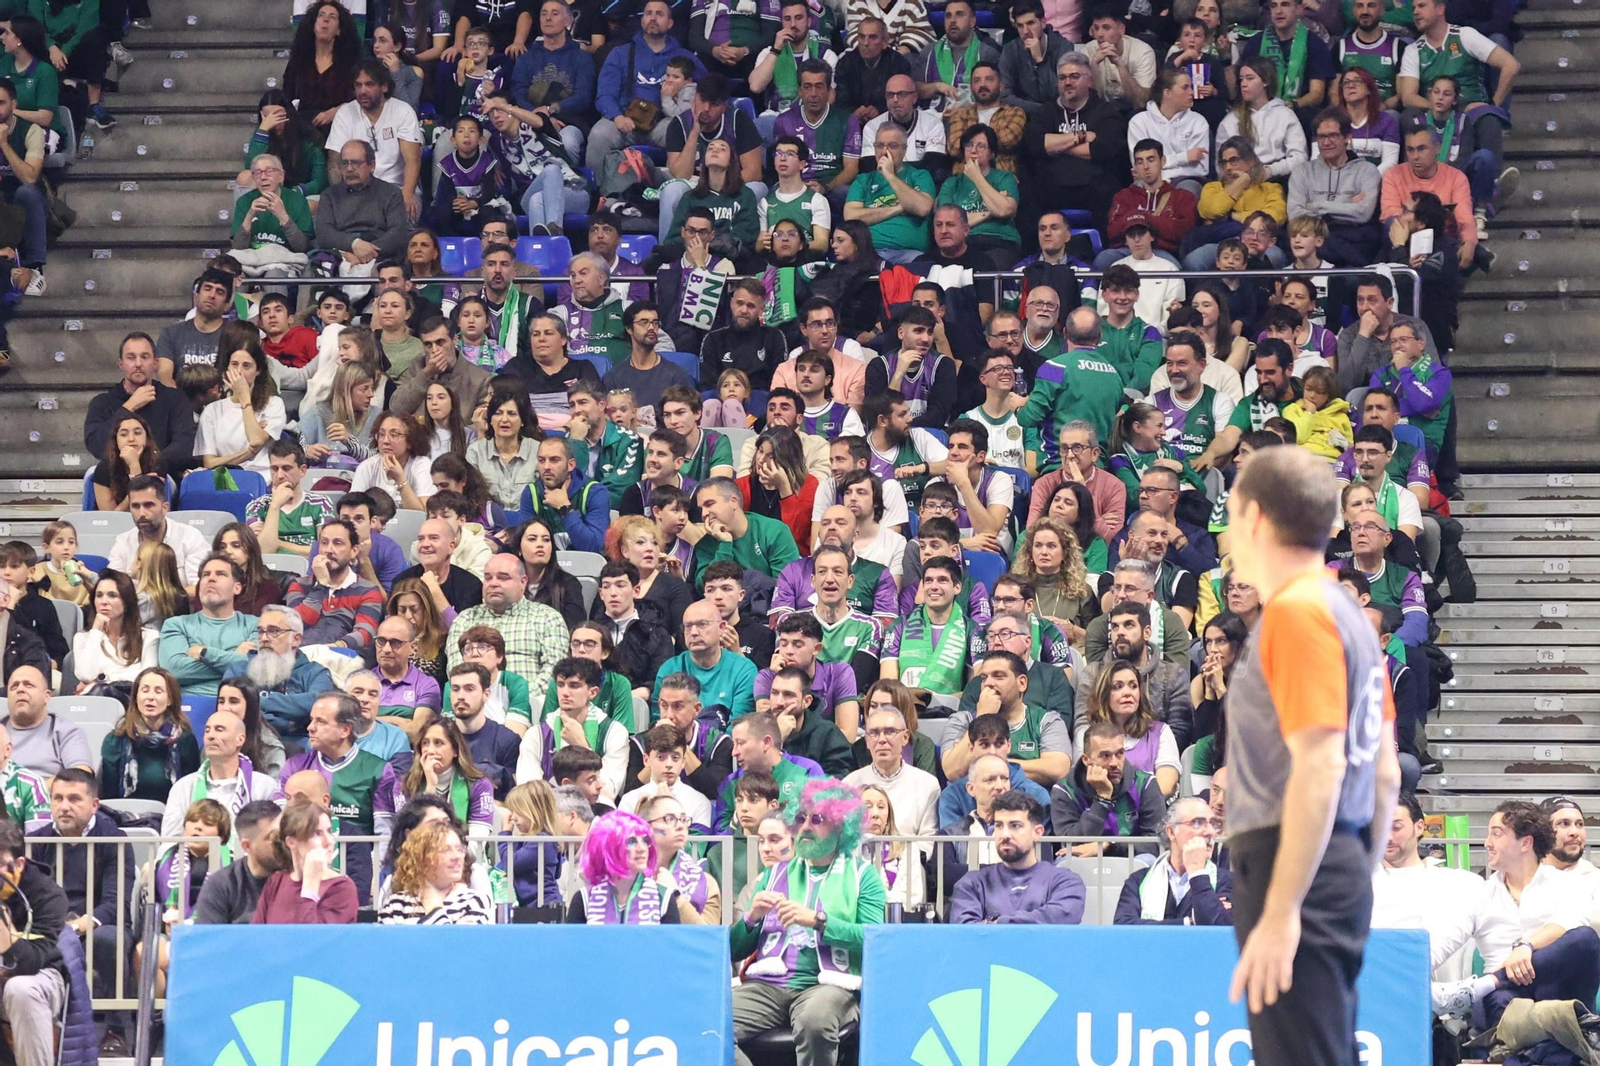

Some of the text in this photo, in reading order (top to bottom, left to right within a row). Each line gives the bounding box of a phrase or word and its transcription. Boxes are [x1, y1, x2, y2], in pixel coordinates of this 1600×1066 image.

[812, 151, 837, 161] Unicaja
[1550, 563, 1564, 571] 10
[1550, 606, 1558, 615] 9
[1545, 749, 1553, 758] 6
[1076, 1010, 1382, 1066] Unica
